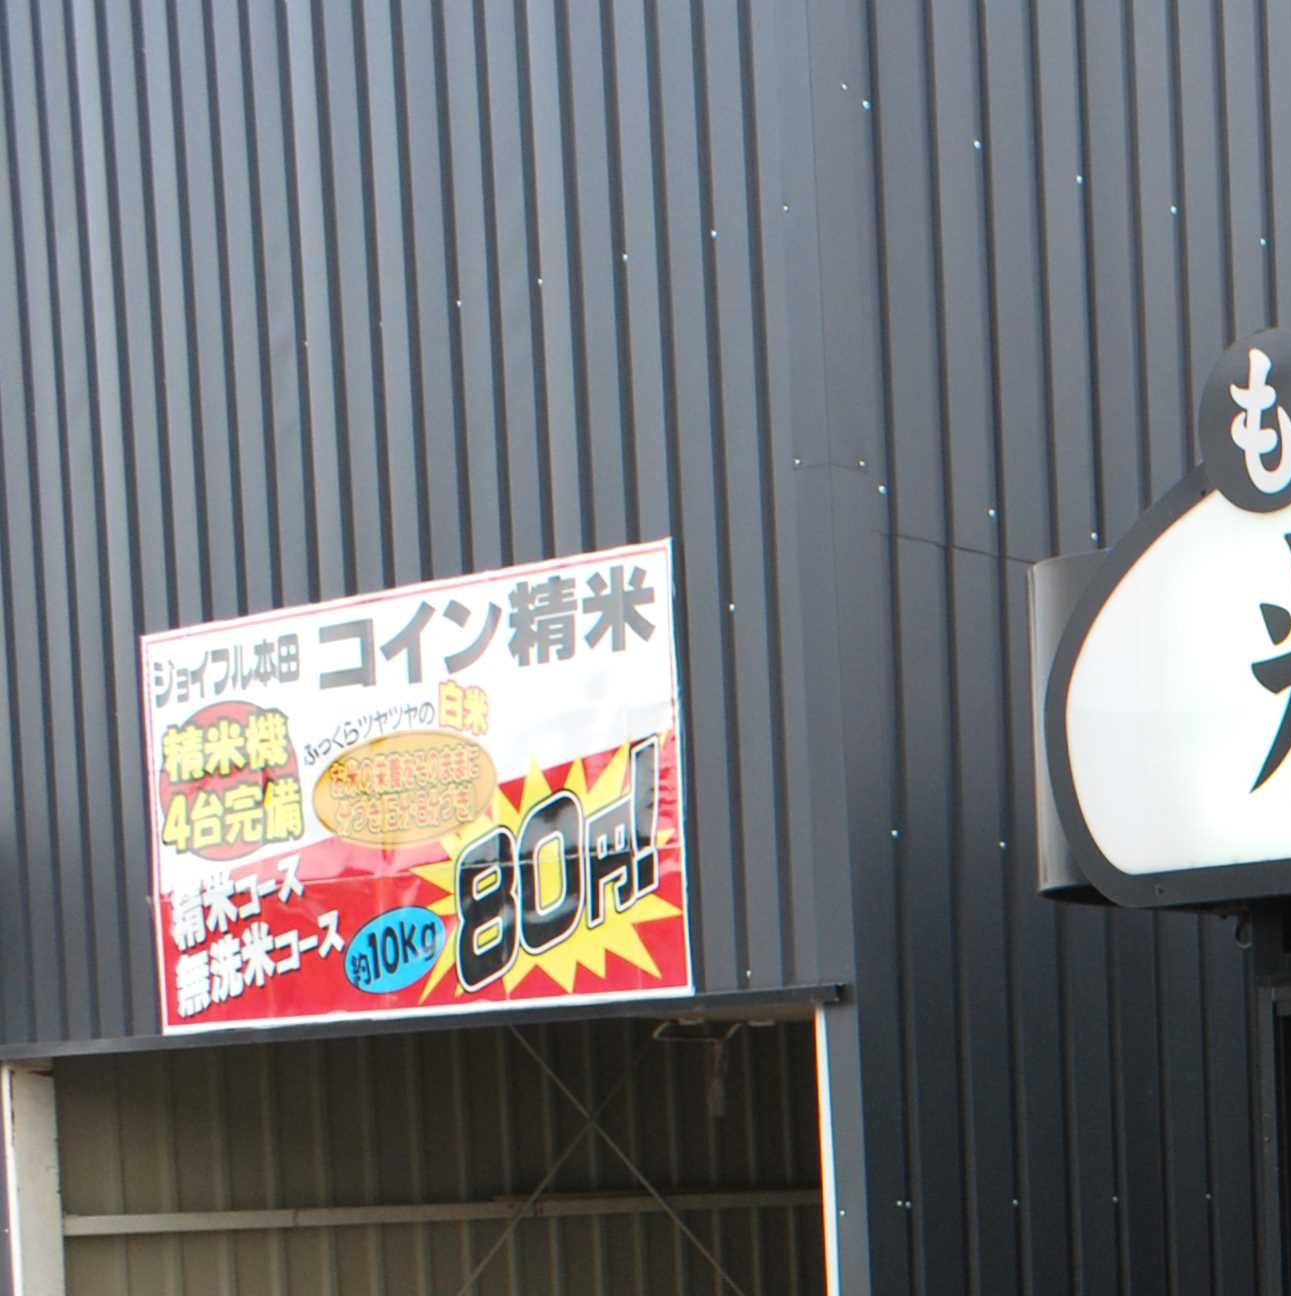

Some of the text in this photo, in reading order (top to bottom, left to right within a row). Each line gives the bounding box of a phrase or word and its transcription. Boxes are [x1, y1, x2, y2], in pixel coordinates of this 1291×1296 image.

[153, 564, 657, 708] ジョイフル本田 コイン精米
[162, 707, 290, 784] 精米機
[304, 679, 490, 765] ふっくらツヤツヤの 白米
[162, 781, 304, 855] 4台完備
[170, 854, 304, 950] 精米コース
[176, 909, 345, 1018] 無洗米コース
[351, 919, 438, 985] 約10kg
